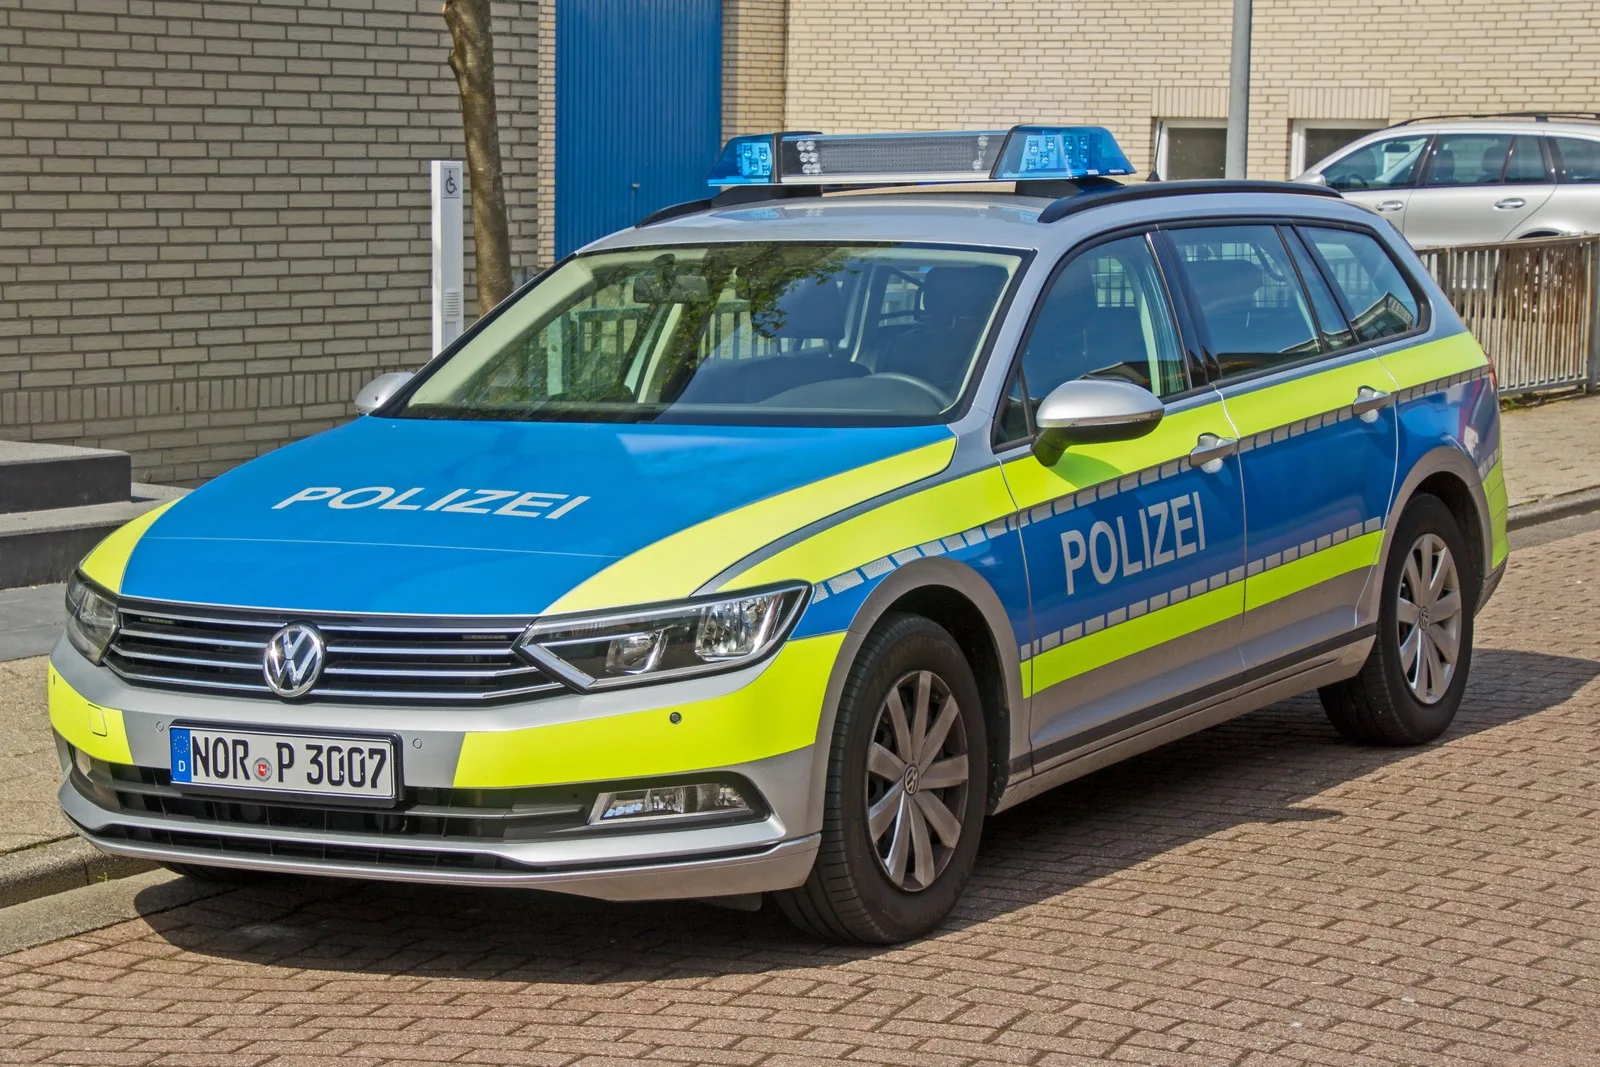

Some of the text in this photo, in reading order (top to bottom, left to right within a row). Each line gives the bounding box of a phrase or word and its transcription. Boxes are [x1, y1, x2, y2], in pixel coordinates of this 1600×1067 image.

[271, 486, 592, 520] POLIZEI
[1060, 491, 1206, 596] POLIZEI
[263, 624, 323, 698] VW
[178, 760, 186, 771] D
[191, 736, 387, 789] NOR P 3007
